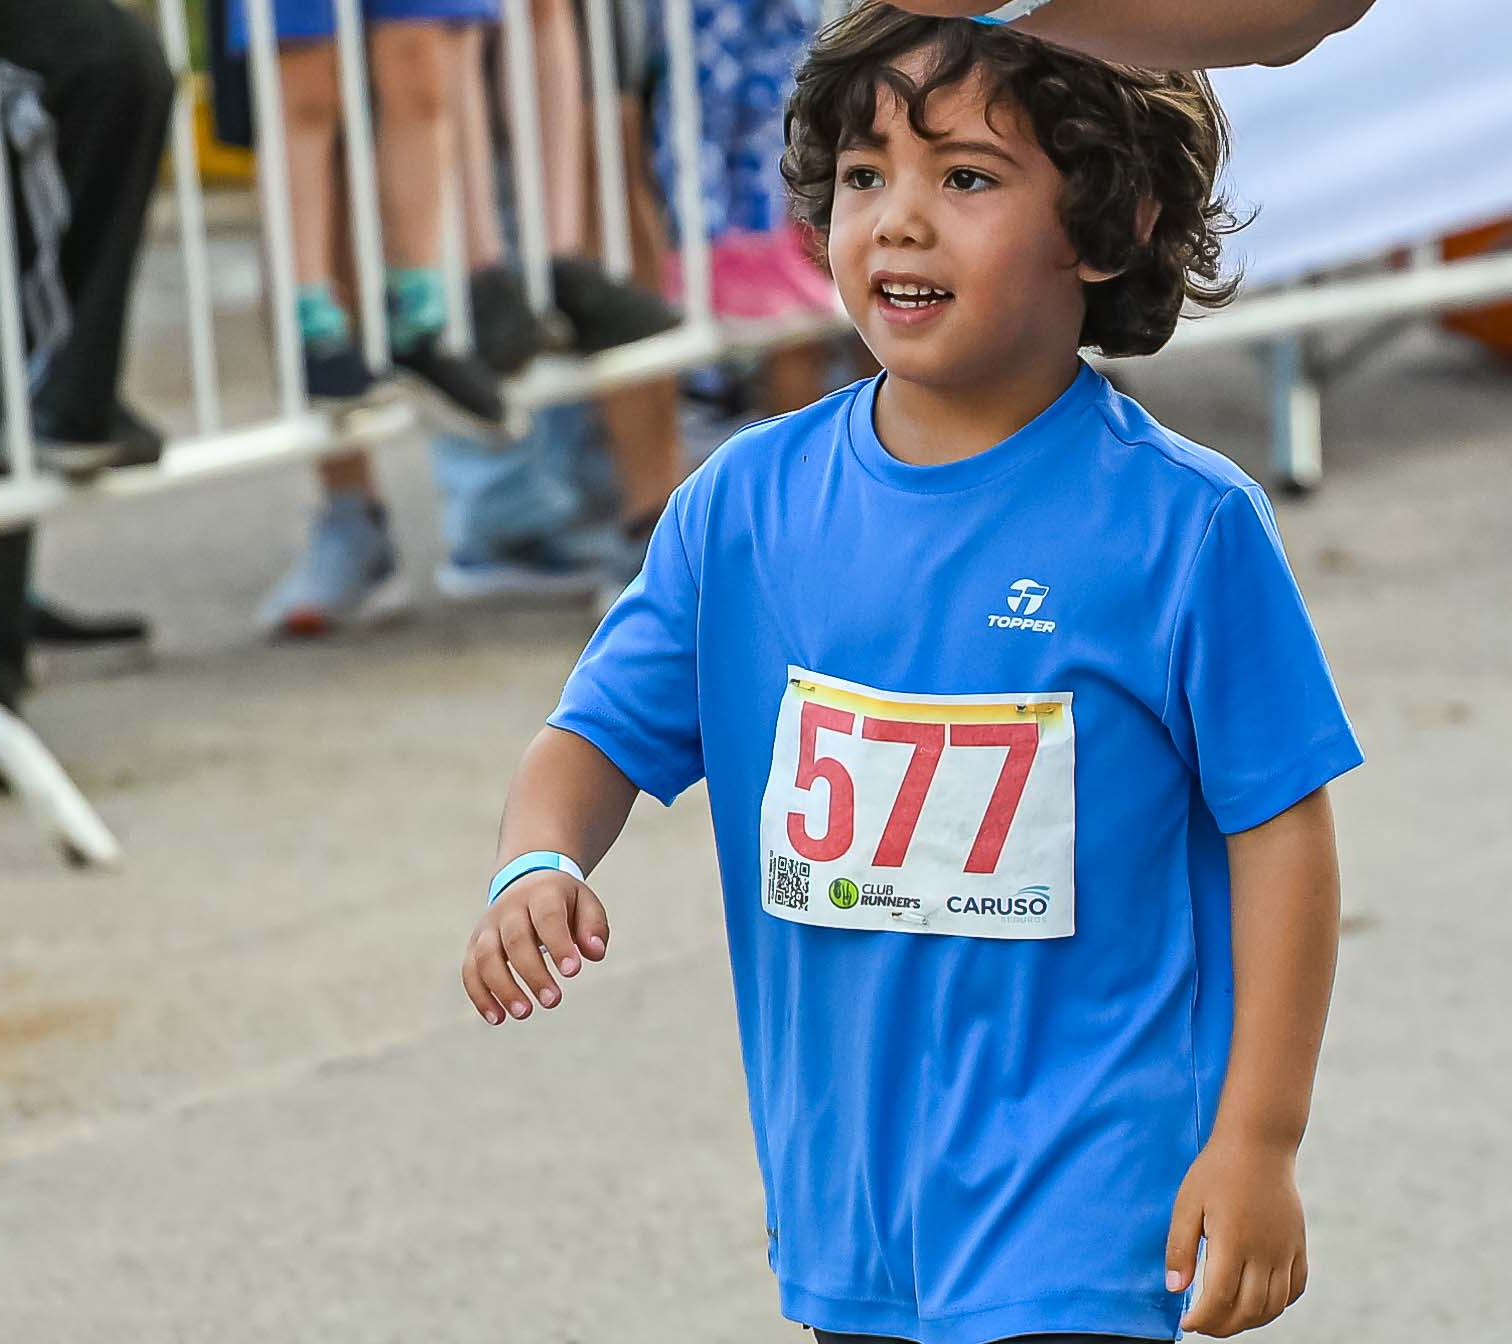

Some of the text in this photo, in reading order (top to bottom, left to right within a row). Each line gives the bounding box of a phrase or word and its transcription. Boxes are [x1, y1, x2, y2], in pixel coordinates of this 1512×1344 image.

[987, 614, 1056, 634] TOPPER
[786, 700, 1040, 875] 577
[861, 883, 894, 896] CLUB
[860, 895, 921, 909] RUNNER'S
[946, 896, 1048, 916] CARUSO
